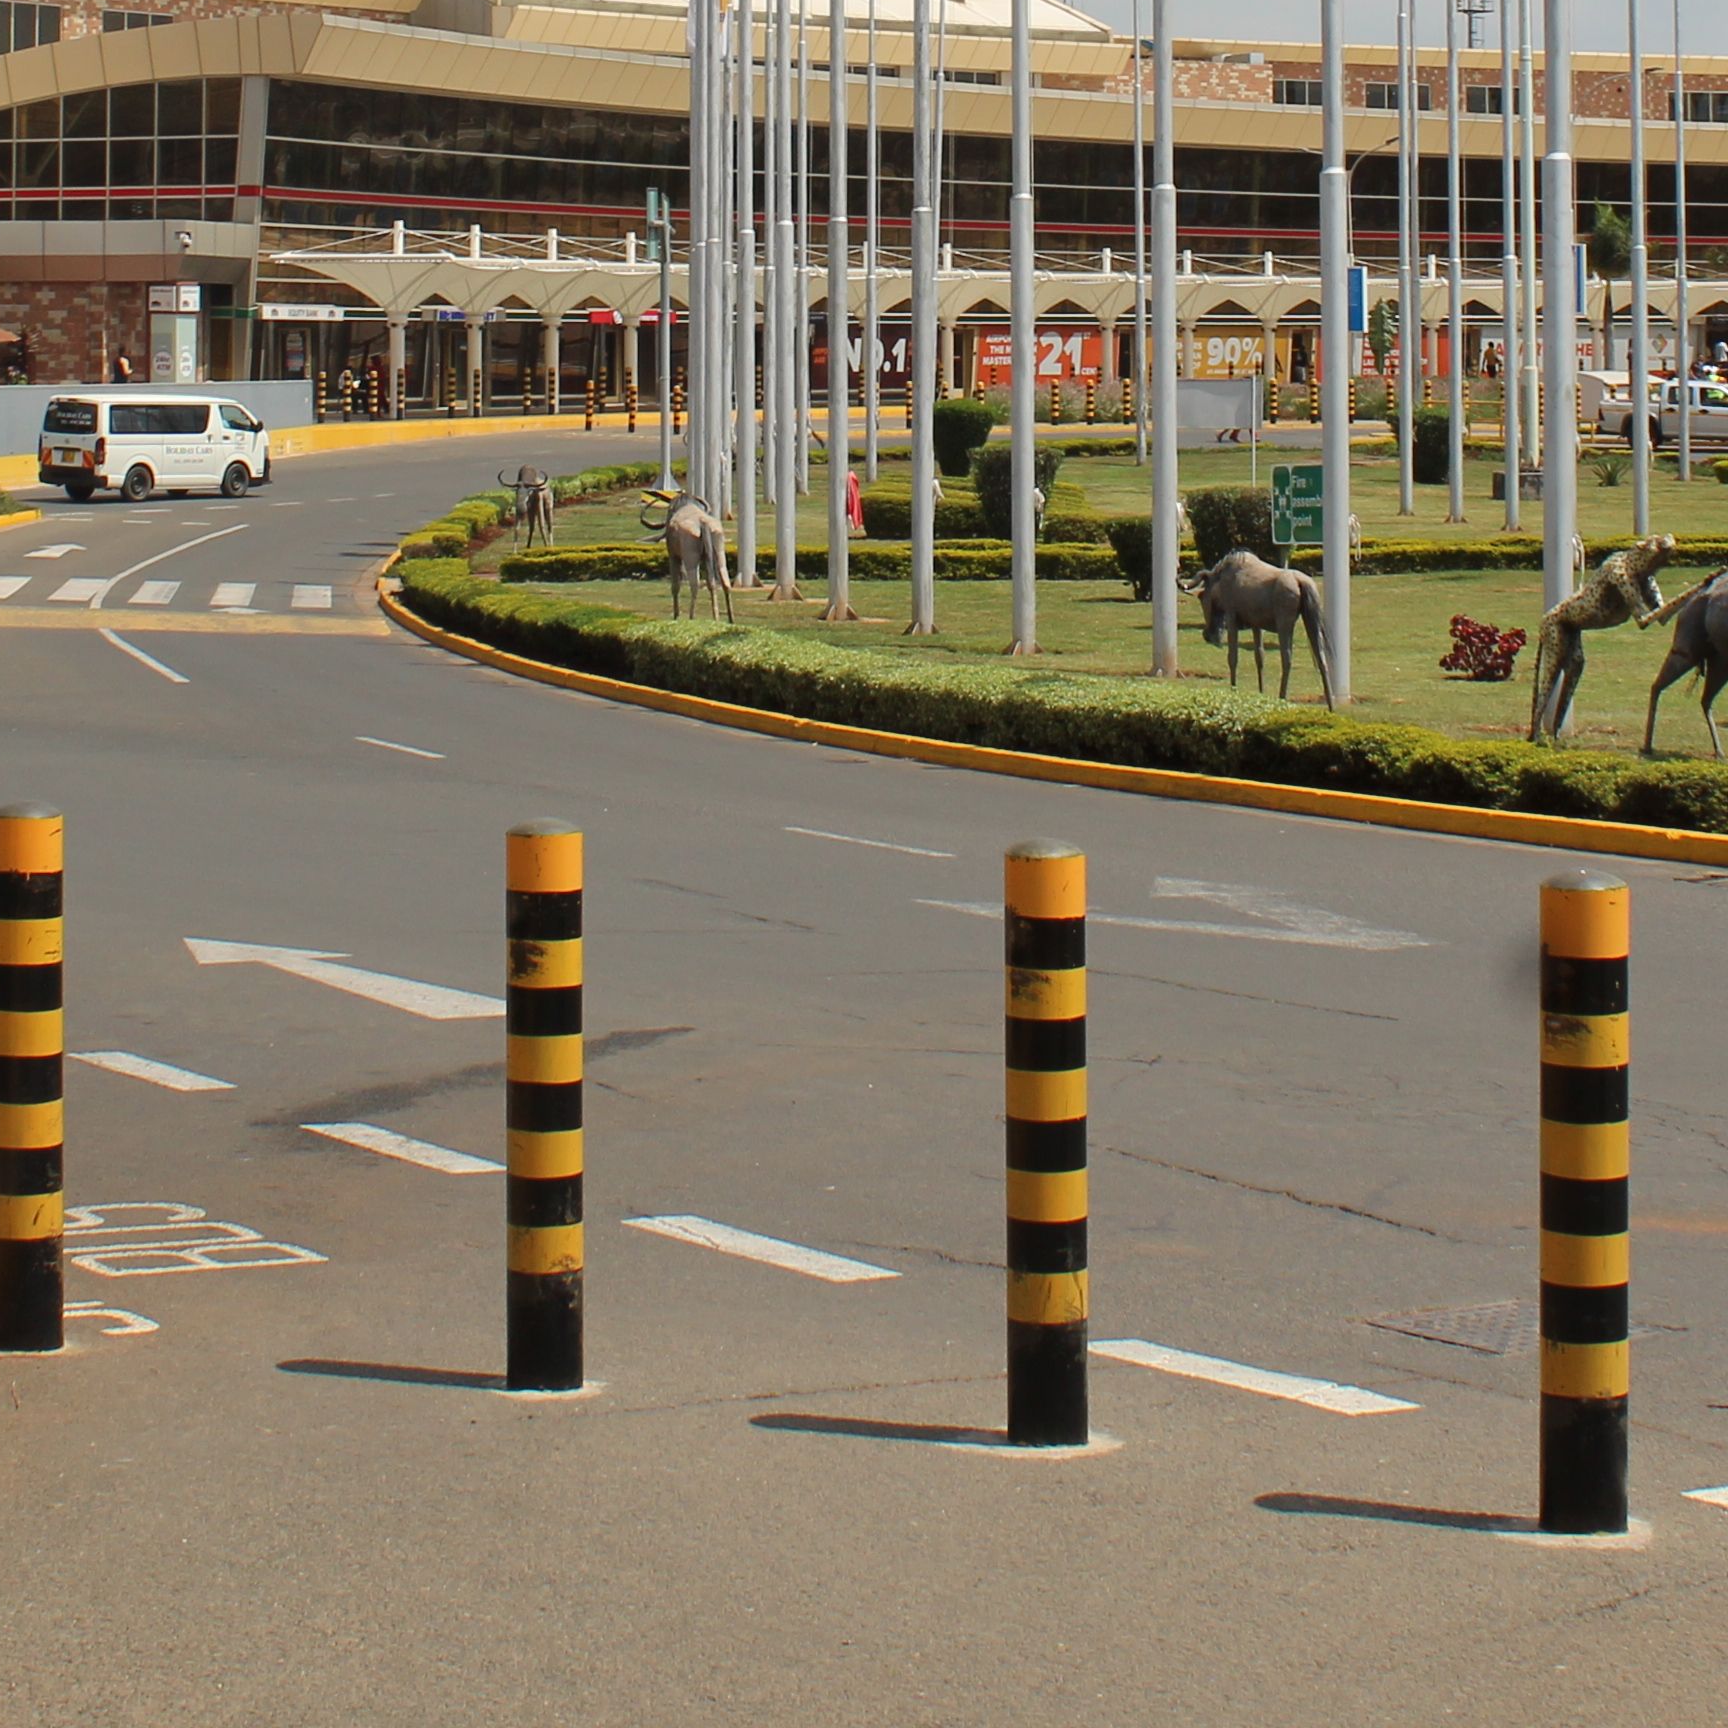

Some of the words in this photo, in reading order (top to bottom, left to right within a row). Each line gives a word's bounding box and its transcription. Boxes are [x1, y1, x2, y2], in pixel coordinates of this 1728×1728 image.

[1207, 336, 1262, 367] 90%
[1292, 475, 1306, 488] Fire
[1292, 493, 1322, 507] assemb
